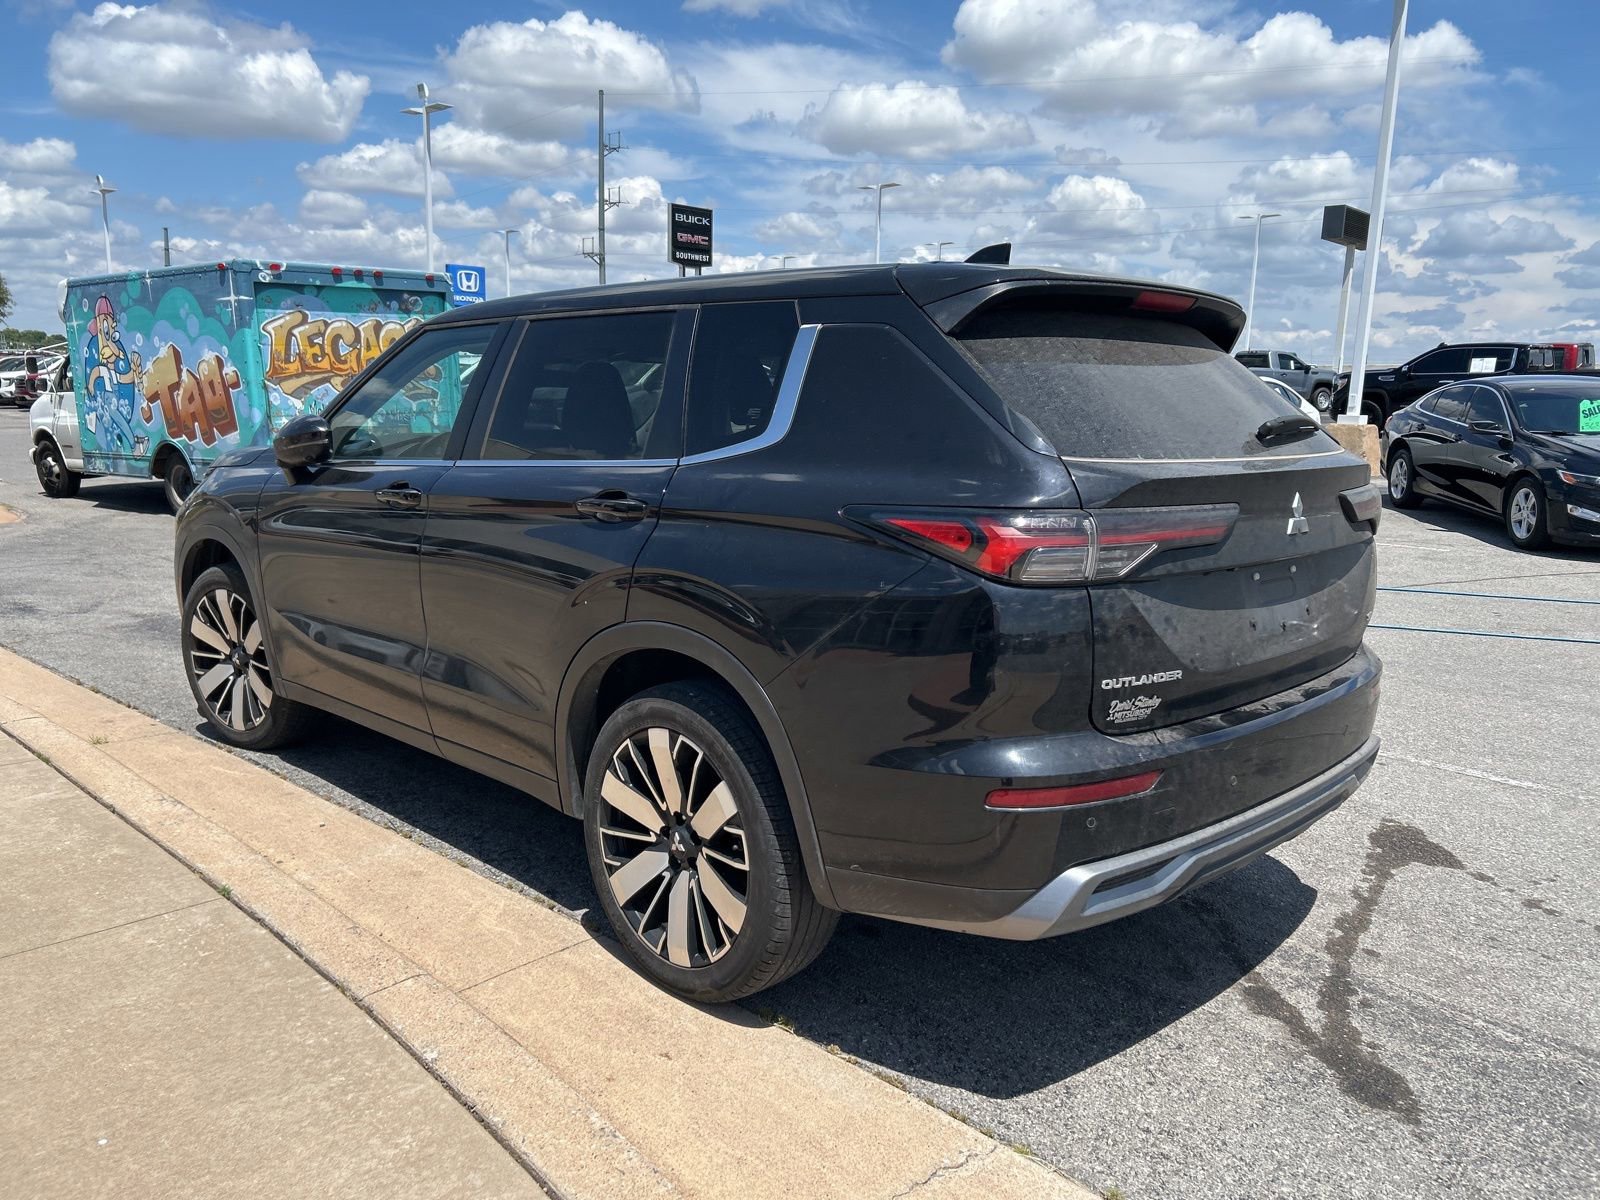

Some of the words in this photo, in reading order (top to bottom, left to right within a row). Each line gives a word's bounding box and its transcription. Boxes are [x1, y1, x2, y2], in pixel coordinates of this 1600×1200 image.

[675, 213, 710, 226] BUICK
[677, 232, 709, 246] GMC
[675, 251, 710, 262] SOUTHWEST
[262, 309, 423, 378] LEGA
[1101, 669, 1183, 690] OUTLANDER
